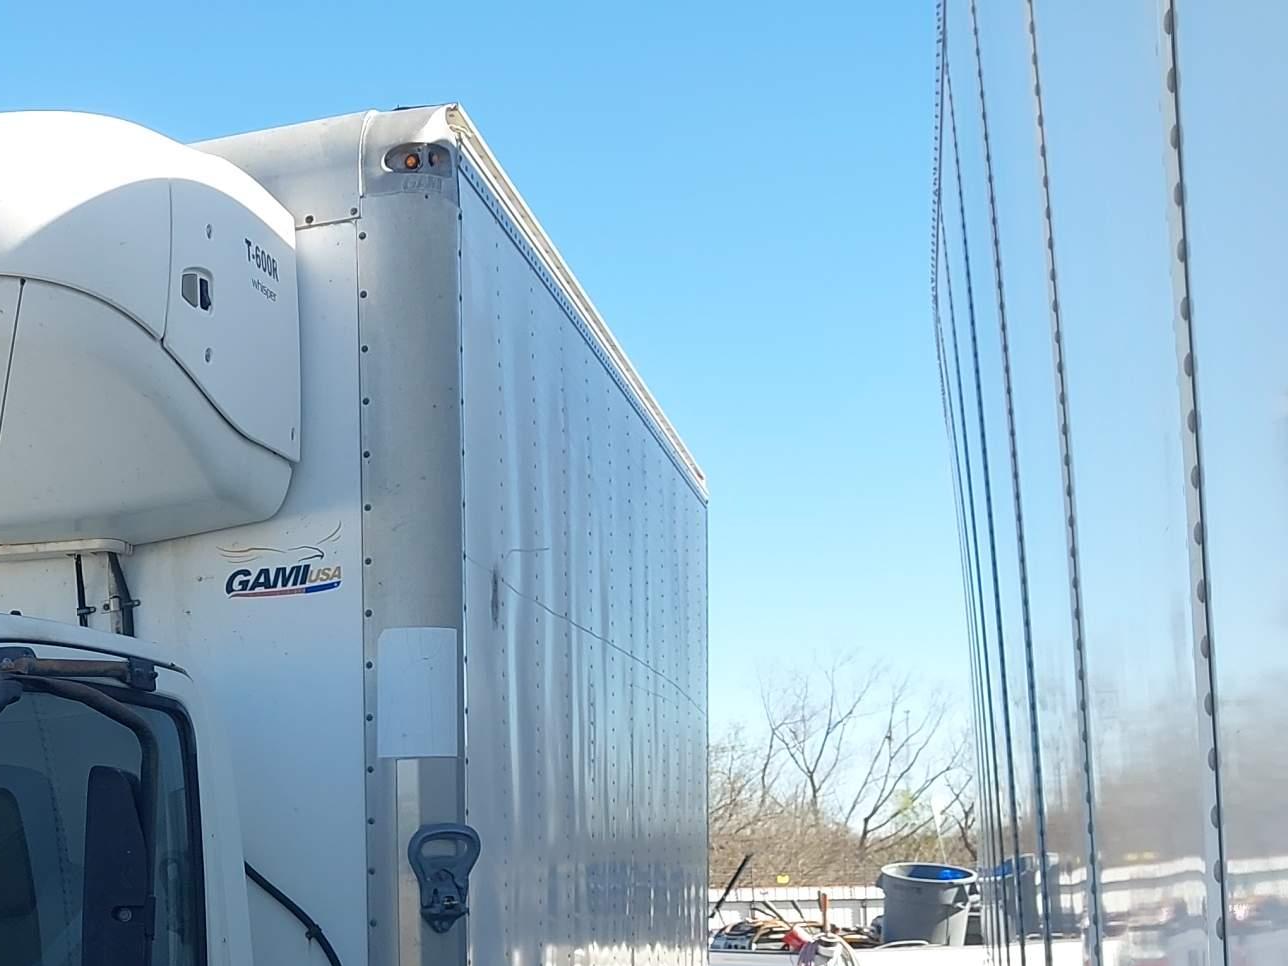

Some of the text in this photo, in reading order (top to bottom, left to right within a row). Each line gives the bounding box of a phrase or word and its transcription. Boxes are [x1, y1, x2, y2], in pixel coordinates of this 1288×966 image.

[244, 238, 279, 282] T-600R
[251, 276, 278, 302] whisper
[225, 563, 342, 595] GAMI USA
